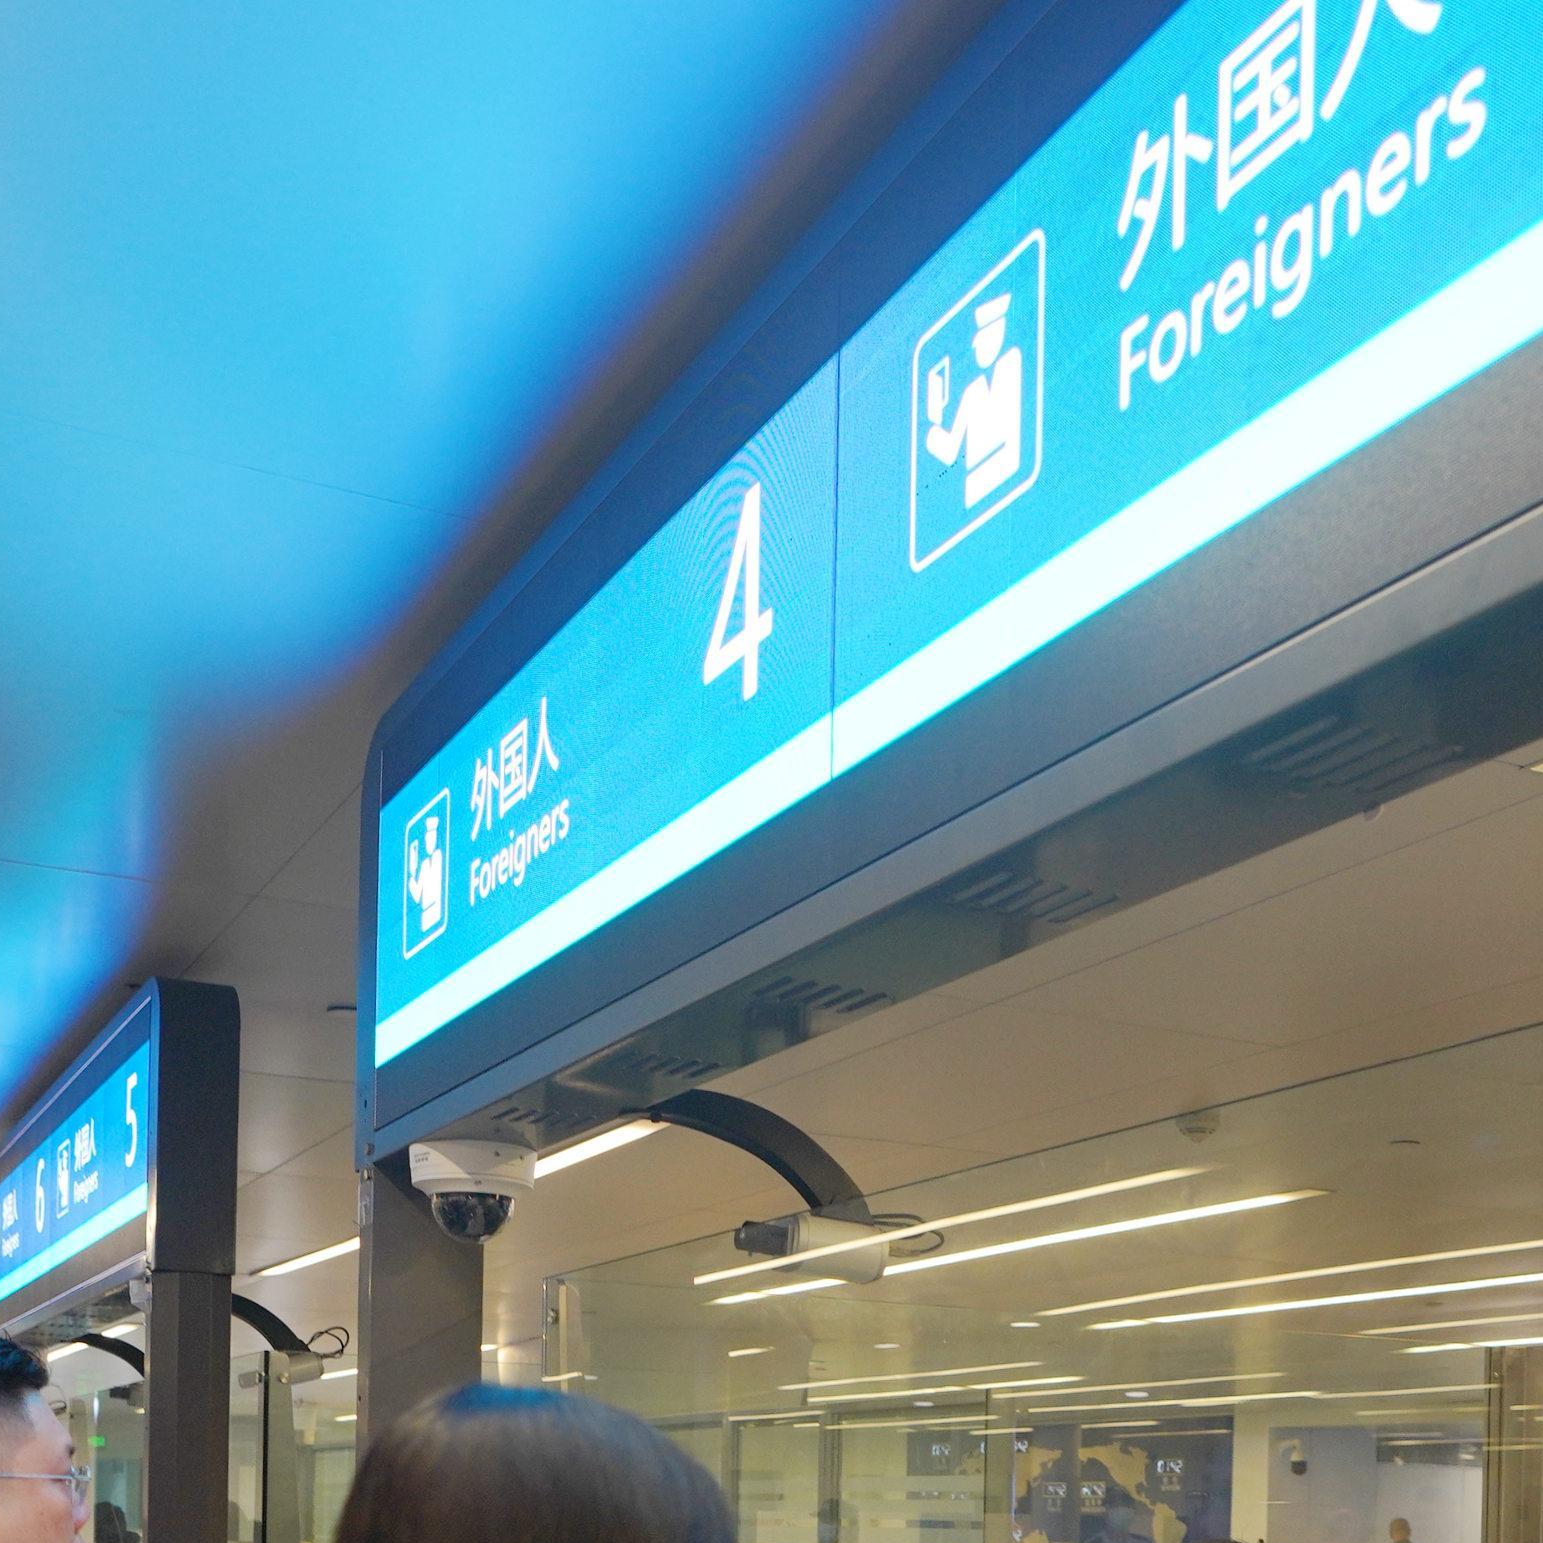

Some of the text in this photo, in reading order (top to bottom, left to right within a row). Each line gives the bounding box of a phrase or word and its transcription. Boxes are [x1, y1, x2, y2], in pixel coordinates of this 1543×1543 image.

[1118, 65, 1487, 412] Foreigners
[703, 481, 773, 702] 4
[470, 696, 559, 841] 外国人
[470, 798, 570, 906] Foreigners
[125, 1072, 138, 1168] 5
[35, 1158, 46, 1234] 6
